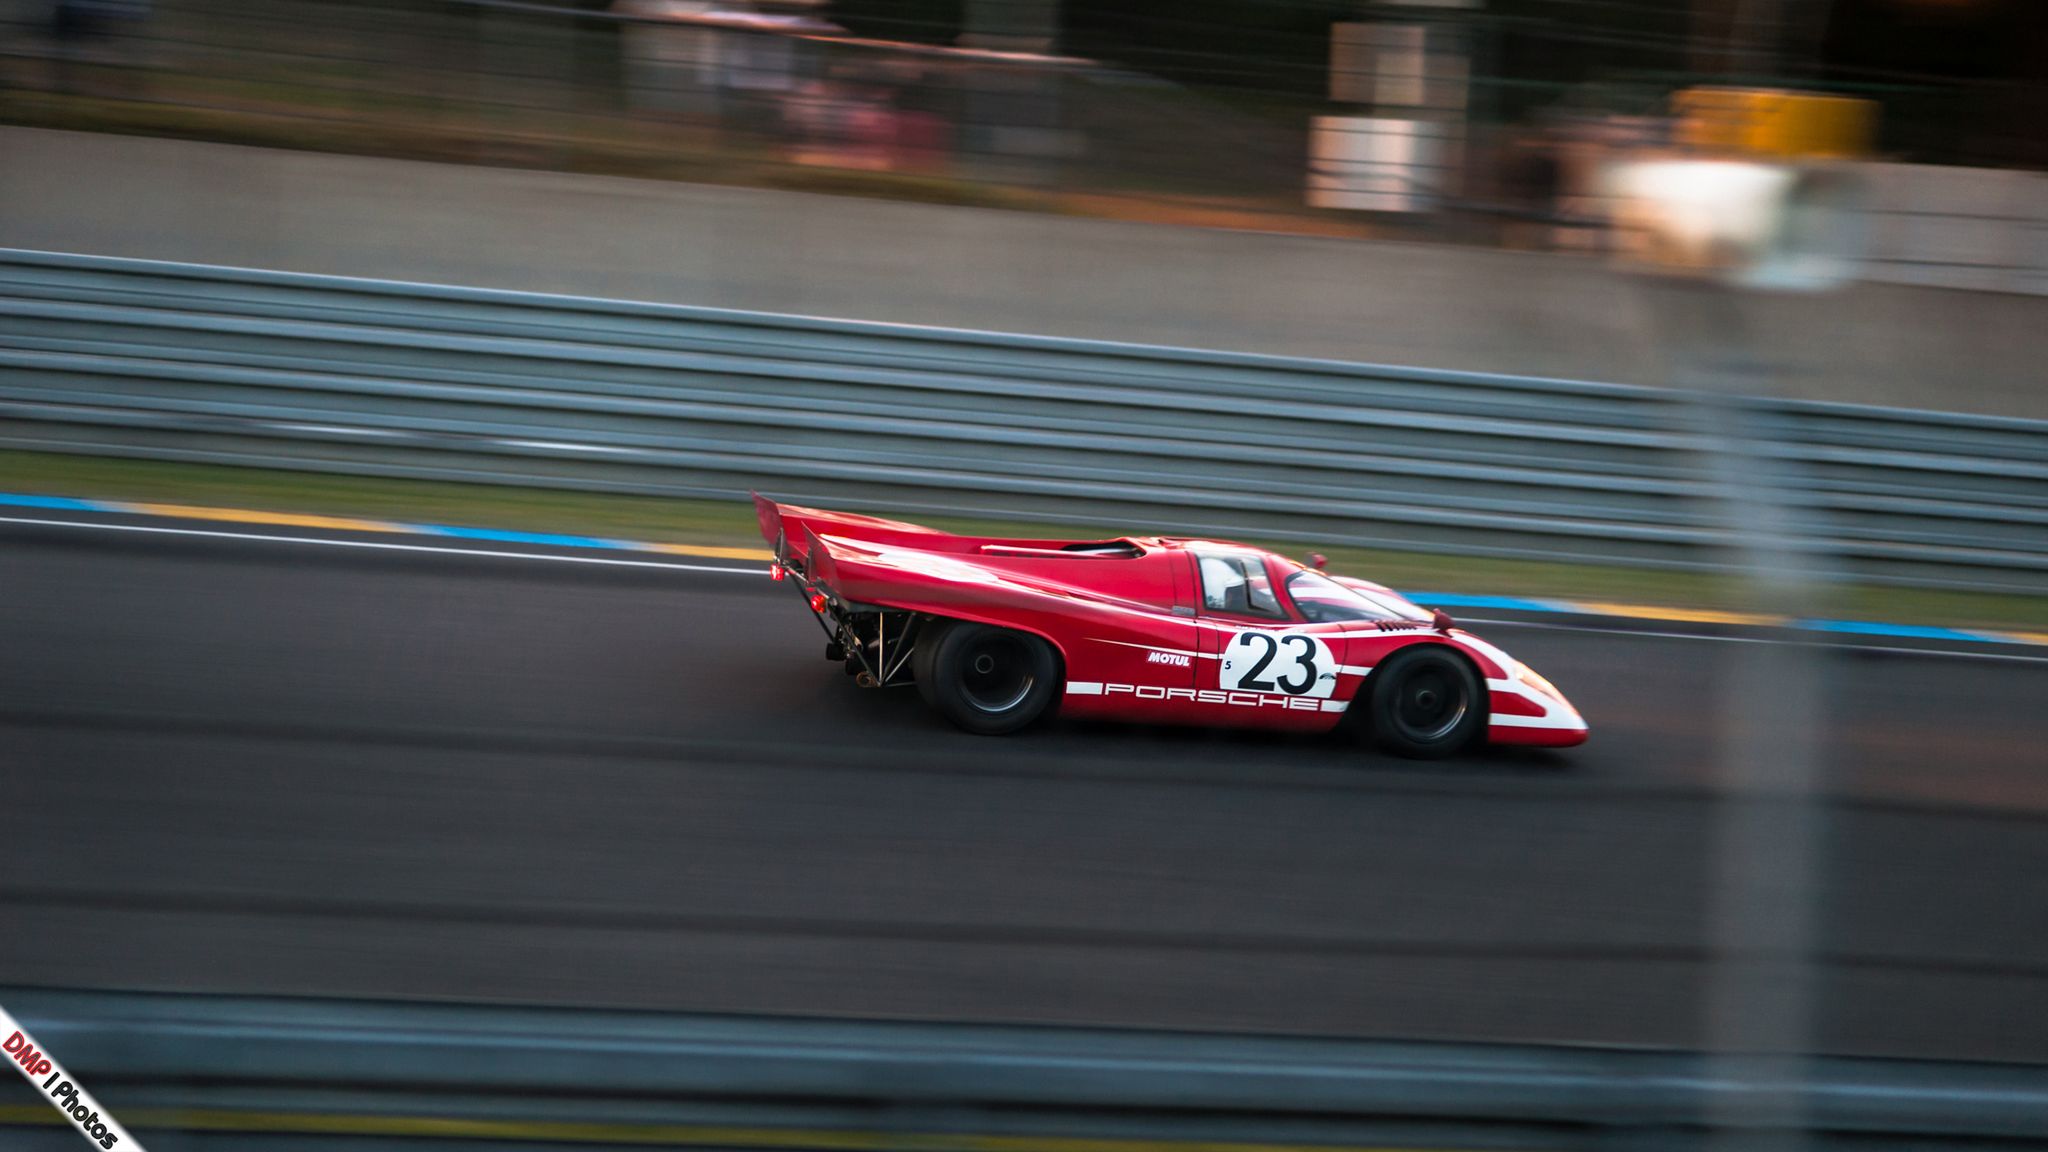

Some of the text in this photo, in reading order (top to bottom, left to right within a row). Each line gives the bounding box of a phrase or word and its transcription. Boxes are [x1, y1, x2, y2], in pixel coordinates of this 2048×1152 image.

[1147, 652, 1190, 667] MOTUL
[1224, 660, 1231, 670] 5
[1237, 632, 1317, 695] 23
[1105, 683, 1319, 711] PORSCHE
